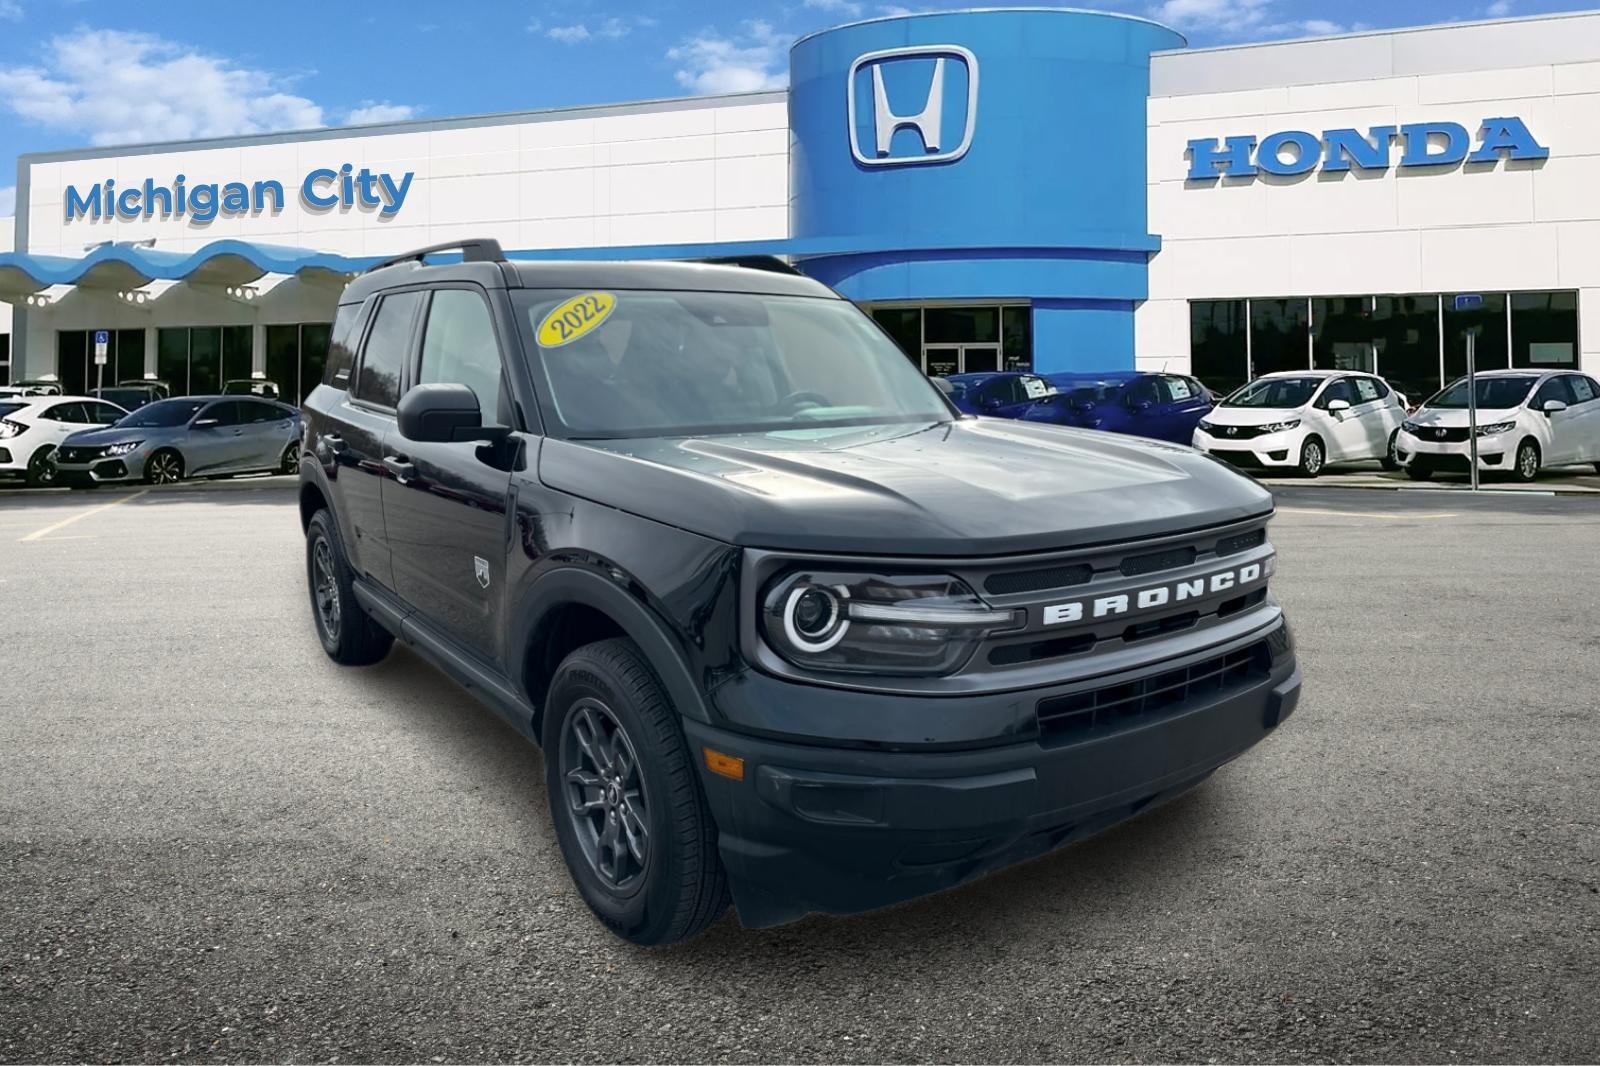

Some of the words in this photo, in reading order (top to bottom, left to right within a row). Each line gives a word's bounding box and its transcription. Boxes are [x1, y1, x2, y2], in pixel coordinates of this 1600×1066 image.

[1186, 116, 1549, 181] HONDA
[65, 174, 284, 222] Michigan
[302, 163, 414, 214] City
[551, 296, 606, 339] 2022
[1043, 563, 1260, 625] BRONCO
